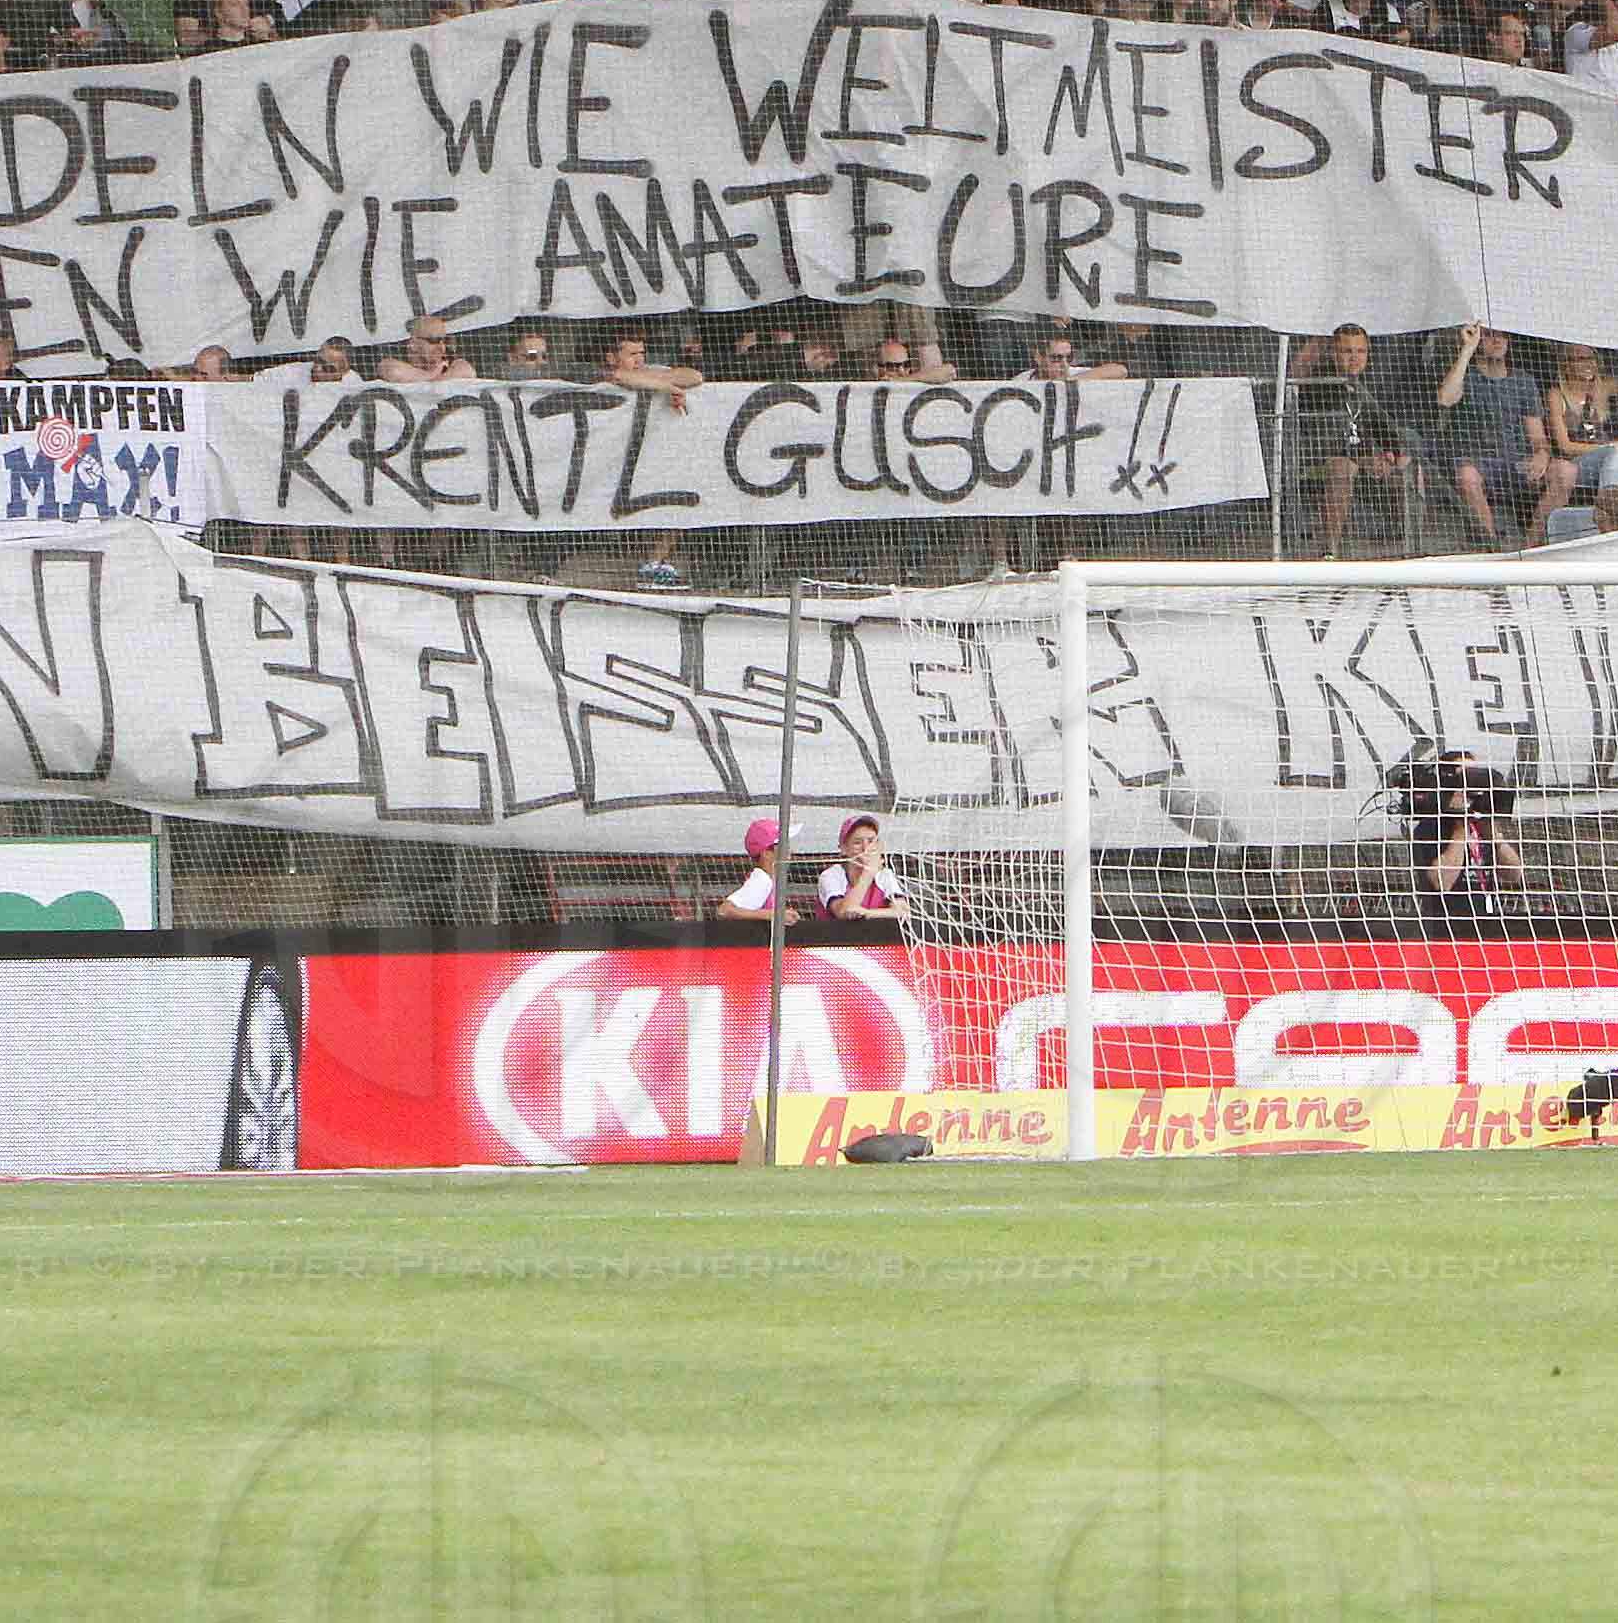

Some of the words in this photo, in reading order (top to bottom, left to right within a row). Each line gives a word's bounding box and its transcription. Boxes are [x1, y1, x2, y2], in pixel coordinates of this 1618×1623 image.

[410, 13, 652, 177] WIE
[215, 195, 486, 342] WIE
[536, 161, 1217, 319] AMATEURE
[560, 985, 850, 1139] KIA
[1120, 1087, 1372, 1156] Antenne
